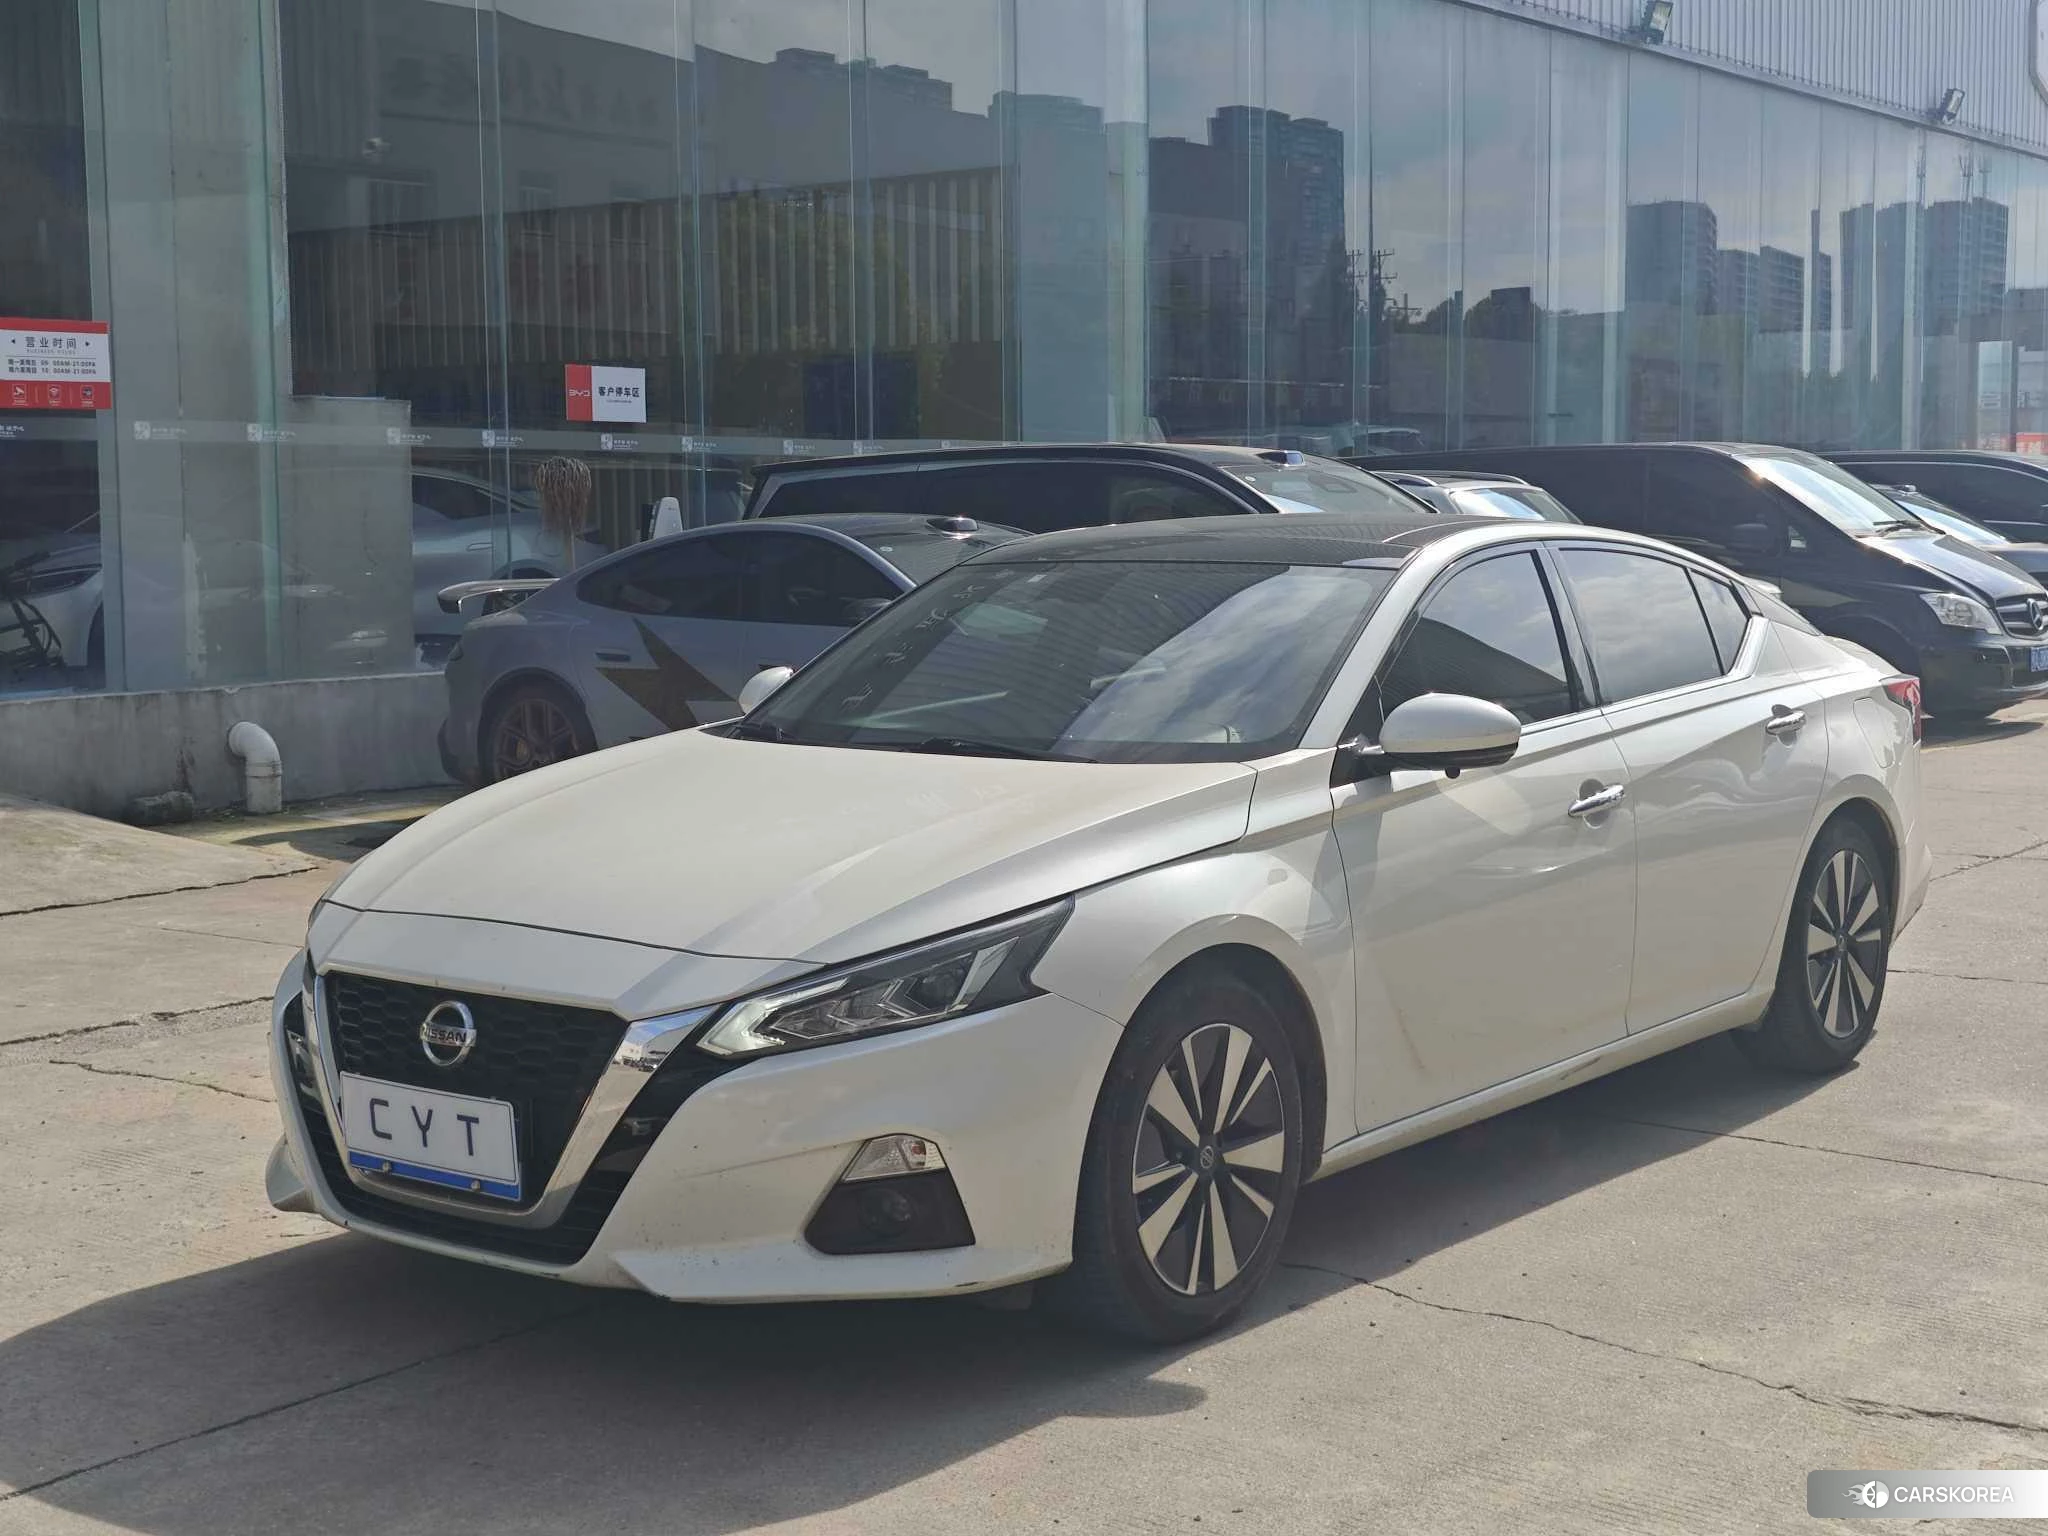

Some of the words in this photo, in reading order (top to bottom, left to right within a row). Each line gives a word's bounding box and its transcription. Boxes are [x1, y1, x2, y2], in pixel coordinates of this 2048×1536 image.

[25, 337, 76, 349] 营业时间
[569, 389, 591, 397] BYD
[599, 386, 640, 398] 客户停车区
